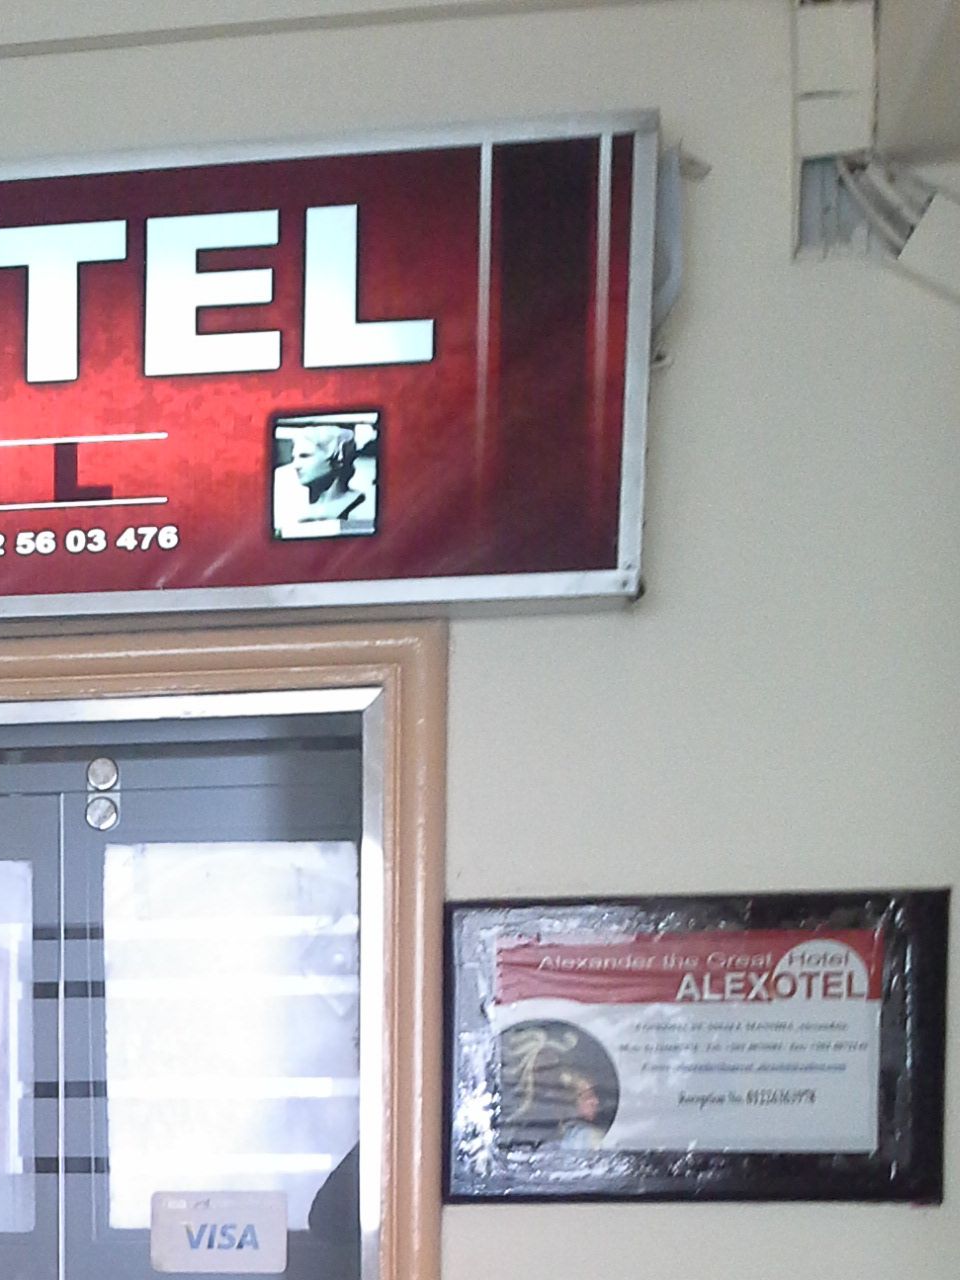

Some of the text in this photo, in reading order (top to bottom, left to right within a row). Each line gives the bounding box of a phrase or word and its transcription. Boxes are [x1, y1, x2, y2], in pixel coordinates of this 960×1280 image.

[15, 531, 56, 555] 56
[65, 529, 107, 553] 03
[116, 526, 179, 550] 476
[537, 949, 850, 971] Alexander the Great Hotel
[675, 970, 867, 1001] ALEXOTEL
[184, 1223, 260, 1250] VISA
